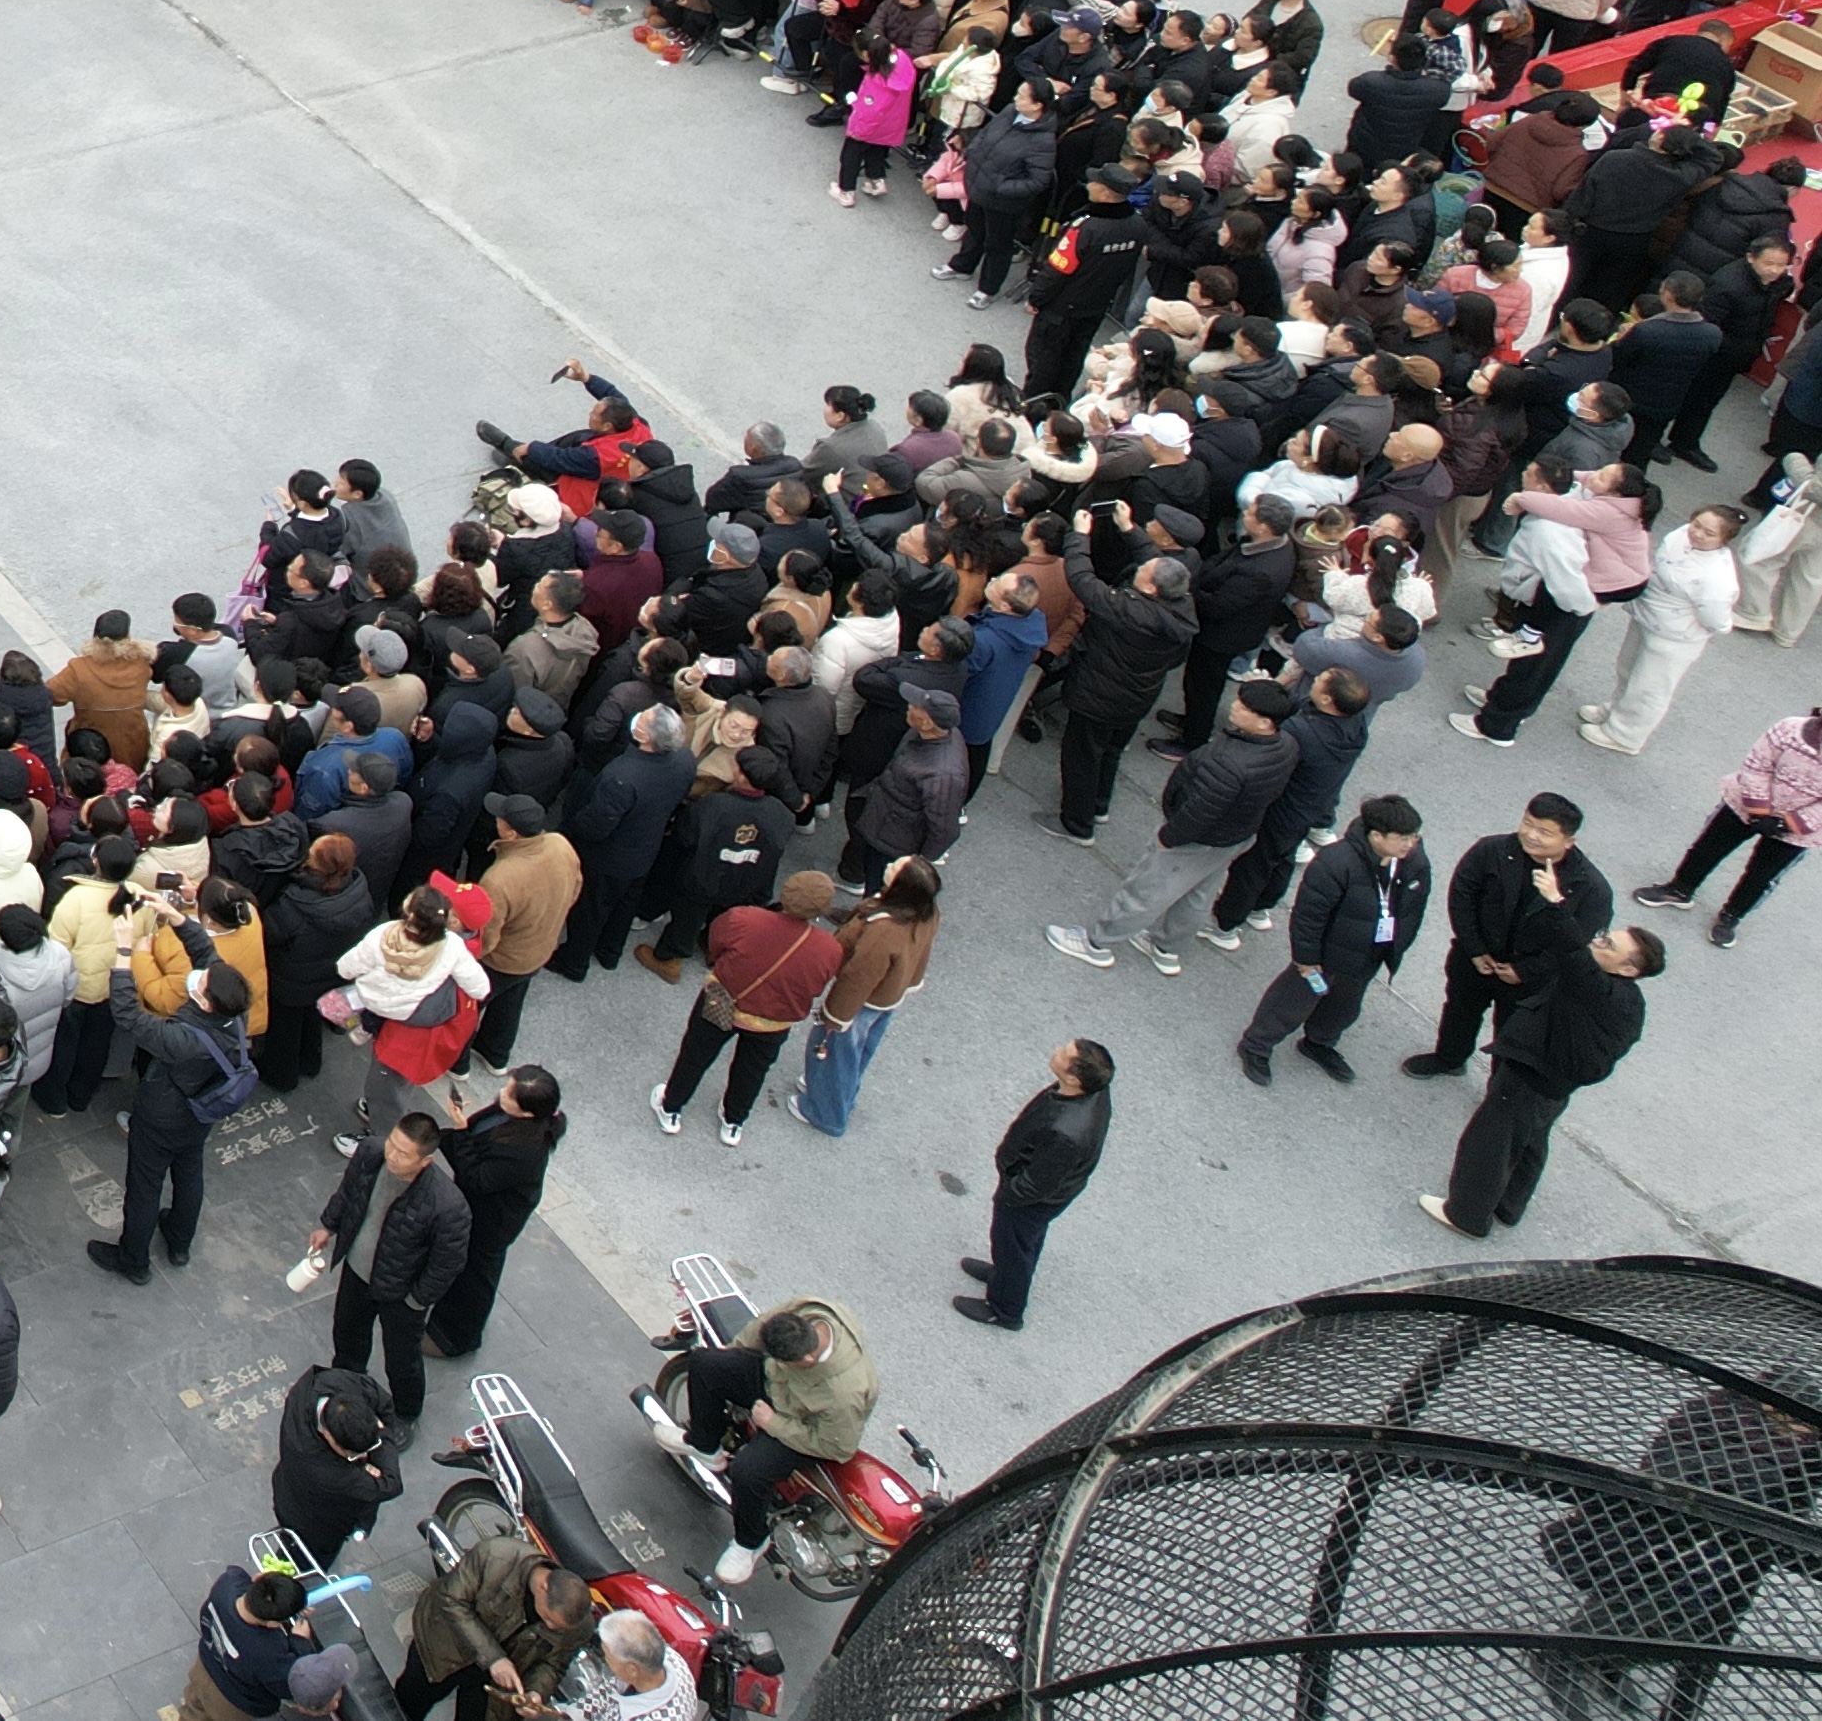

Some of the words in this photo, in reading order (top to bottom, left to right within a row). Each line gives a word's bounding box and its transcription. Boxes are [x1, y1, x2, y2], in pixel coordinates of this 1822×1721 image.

[214, 1114, 320, 1166] 广彩瓷烧
[211, 1353, 288, 1400] 制技艺
[213, 1382, 291, 1433] 溪瓷烧
